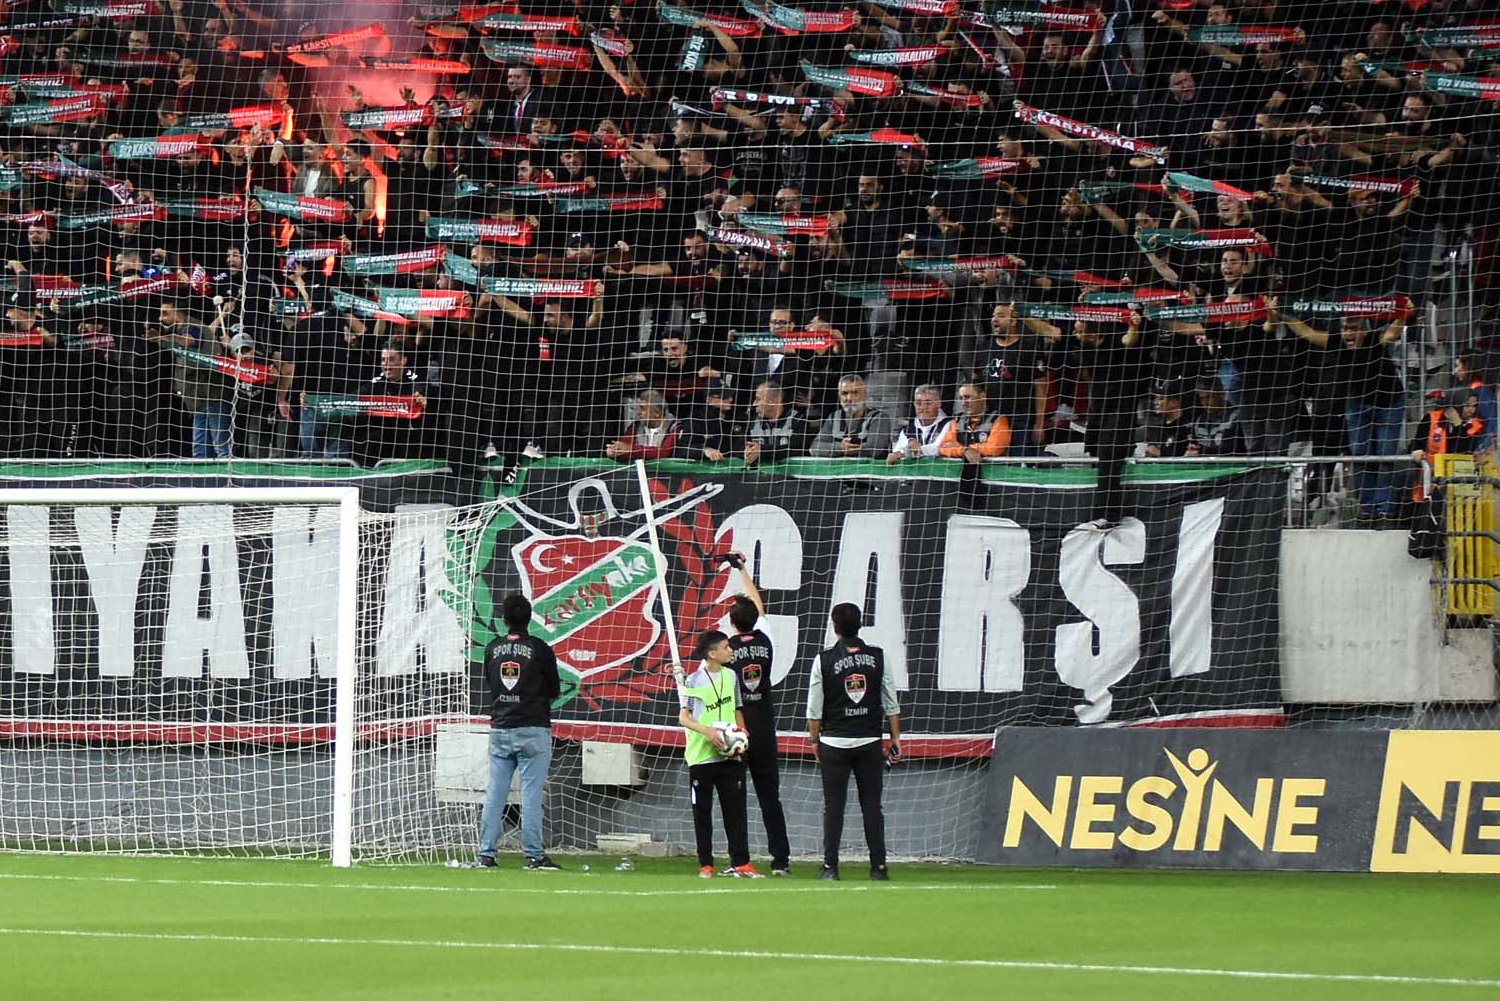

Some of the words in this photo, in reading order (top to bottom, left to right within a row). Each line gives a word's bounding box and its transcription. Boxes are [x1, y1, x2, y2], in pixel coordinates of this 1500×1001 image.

[492, 643, 512, 660] SPOR
[513, 642, 533, 660] ŞUBE
[750, 644, 770, 660] ŞUBE
[834, 655, 855, 675] SPOR
